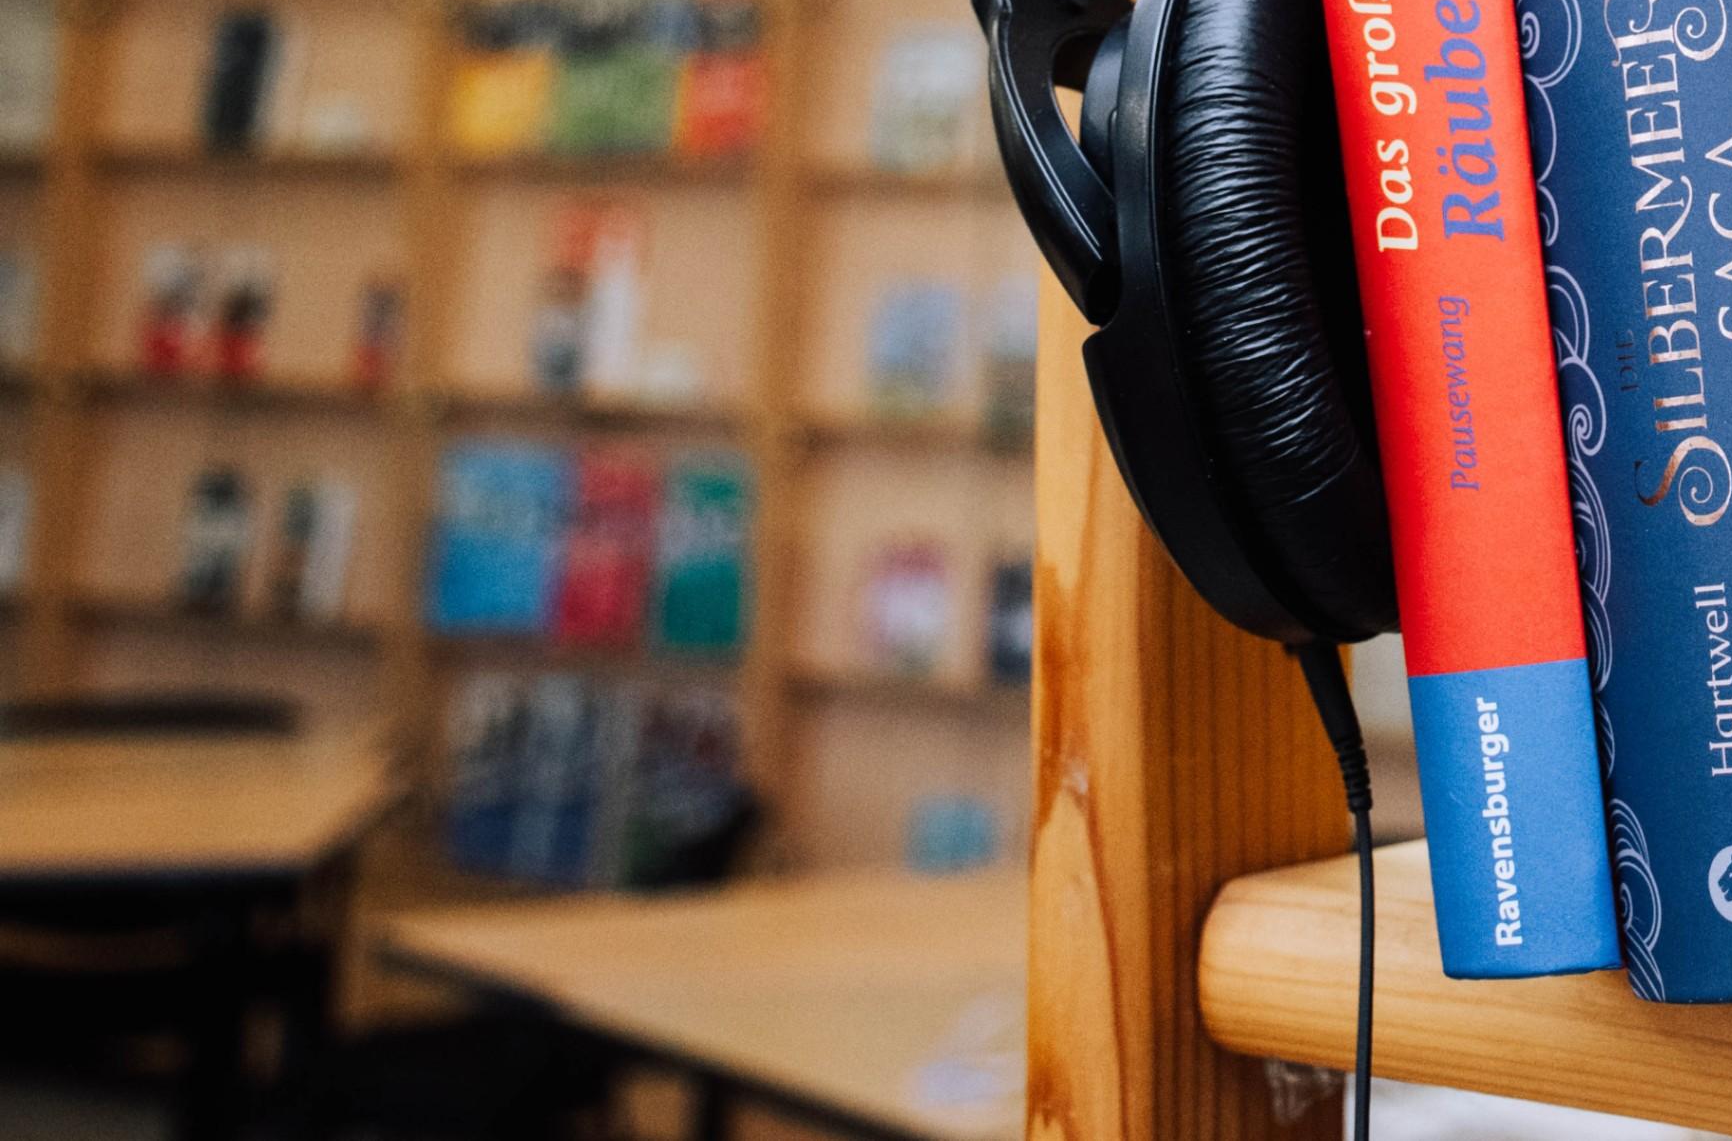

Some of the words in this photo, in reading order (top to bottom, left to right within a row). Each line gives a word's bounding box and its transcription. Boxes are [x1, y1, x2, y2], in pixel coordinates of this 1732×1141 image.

[1375, 138, 1419, 253] Das
[1438, 294, 1480, 491] Pausewang
[1475, 695, 1523, 947] Ravensburger
